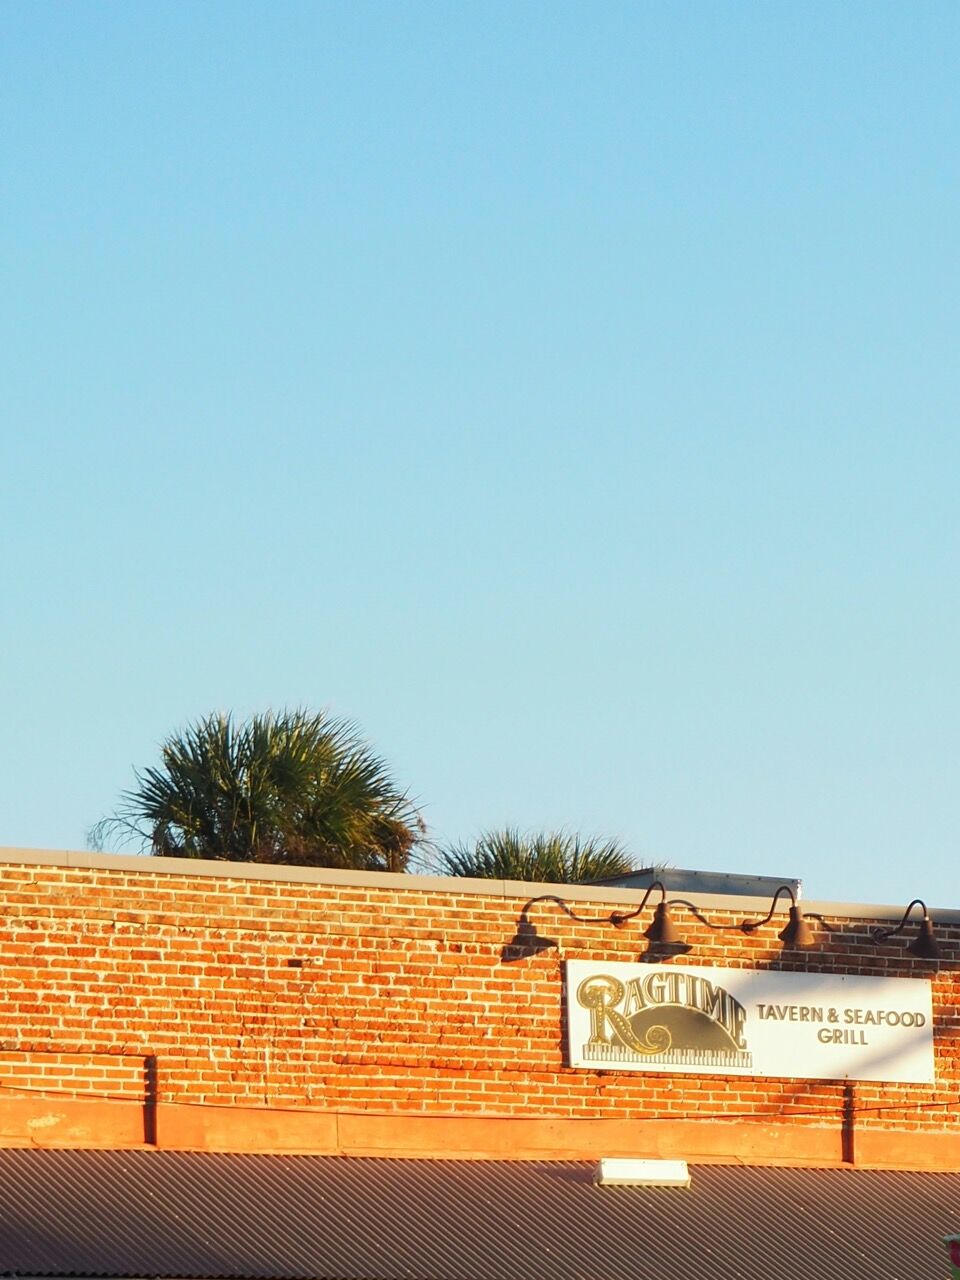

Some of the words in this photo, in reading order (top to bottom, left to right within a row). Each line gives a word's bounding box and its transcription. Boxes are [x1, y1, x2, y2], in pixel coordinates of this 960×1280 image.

[576, 972, 748, 1056] RAGTIME
[756, 1004, 823, 1023] TAVERN
[827, 1008, 839, 1023] &
[844, 1008, 926, 1028] SEAFOOD
[817, 1029, 868, 1046] GRILL
